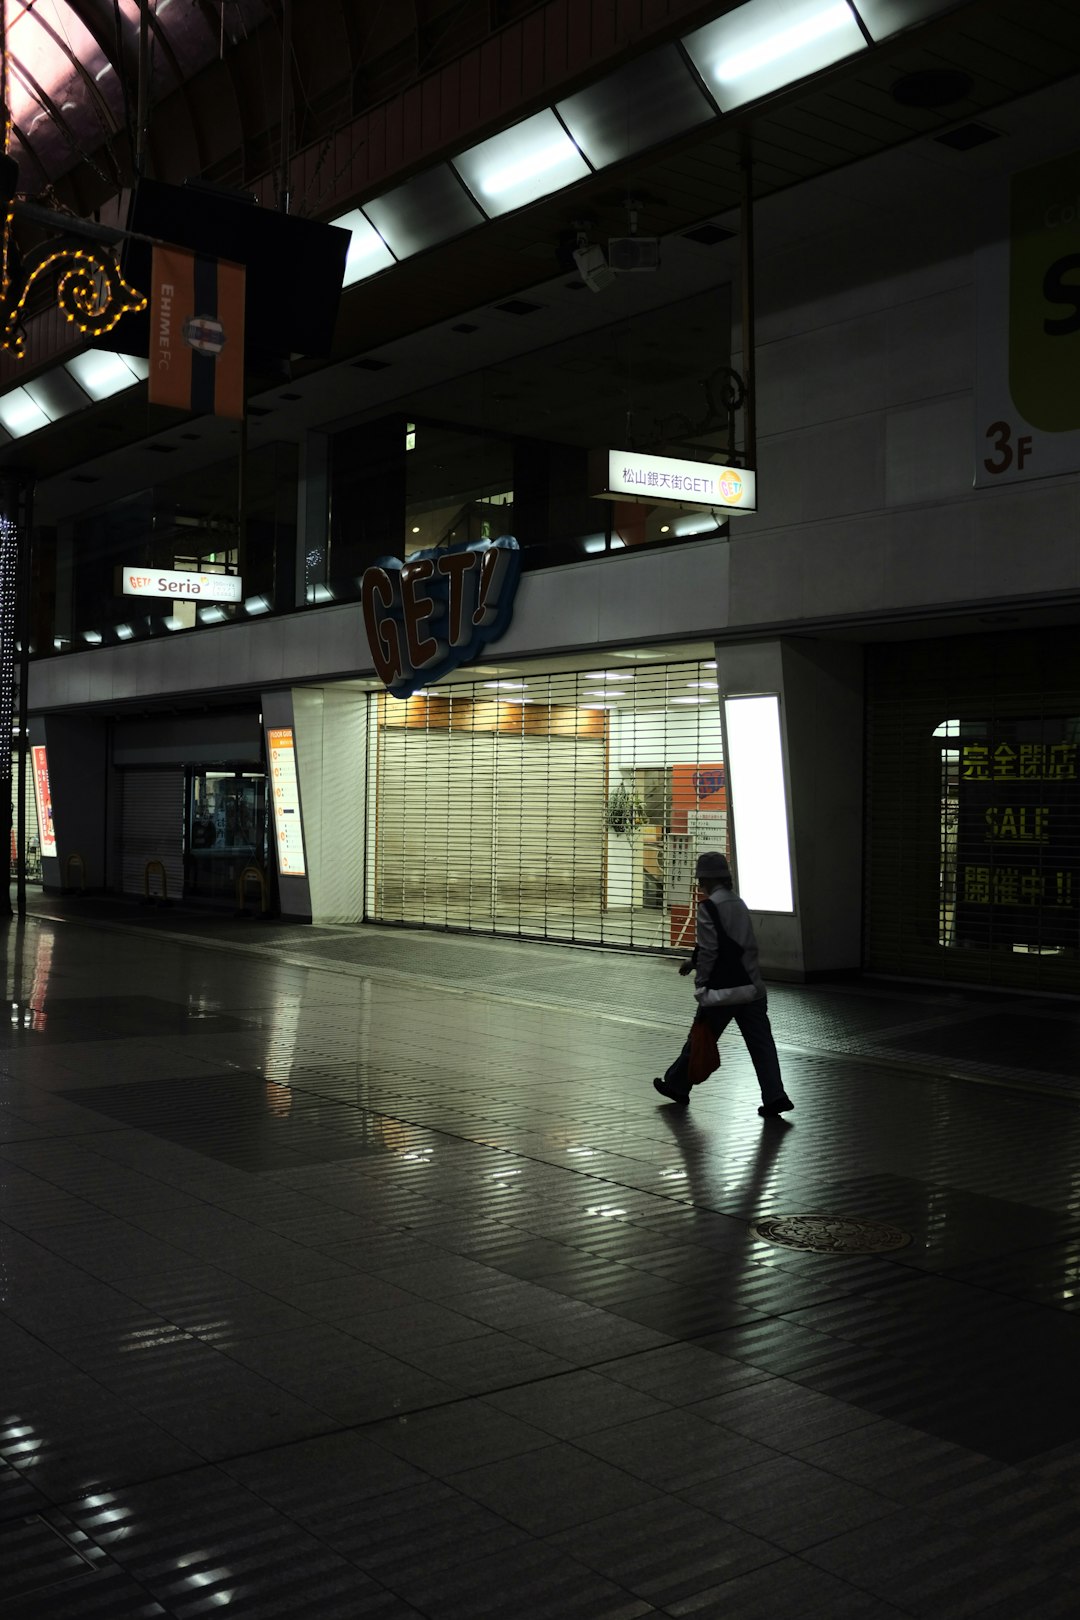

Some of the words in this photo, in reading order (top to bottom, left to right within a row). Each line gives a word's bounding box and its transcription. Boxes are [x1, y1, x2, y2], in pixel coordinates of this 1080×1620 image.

[160, 284, 174, 348] EHIME
[158, 350, 171, 370] FC
[984, 420, 1033, 474] 3F
[158, 578, 201, 594] Seria
[361, 547, 500, 687] GET!
[984, 807, 1050, 844] SALE
